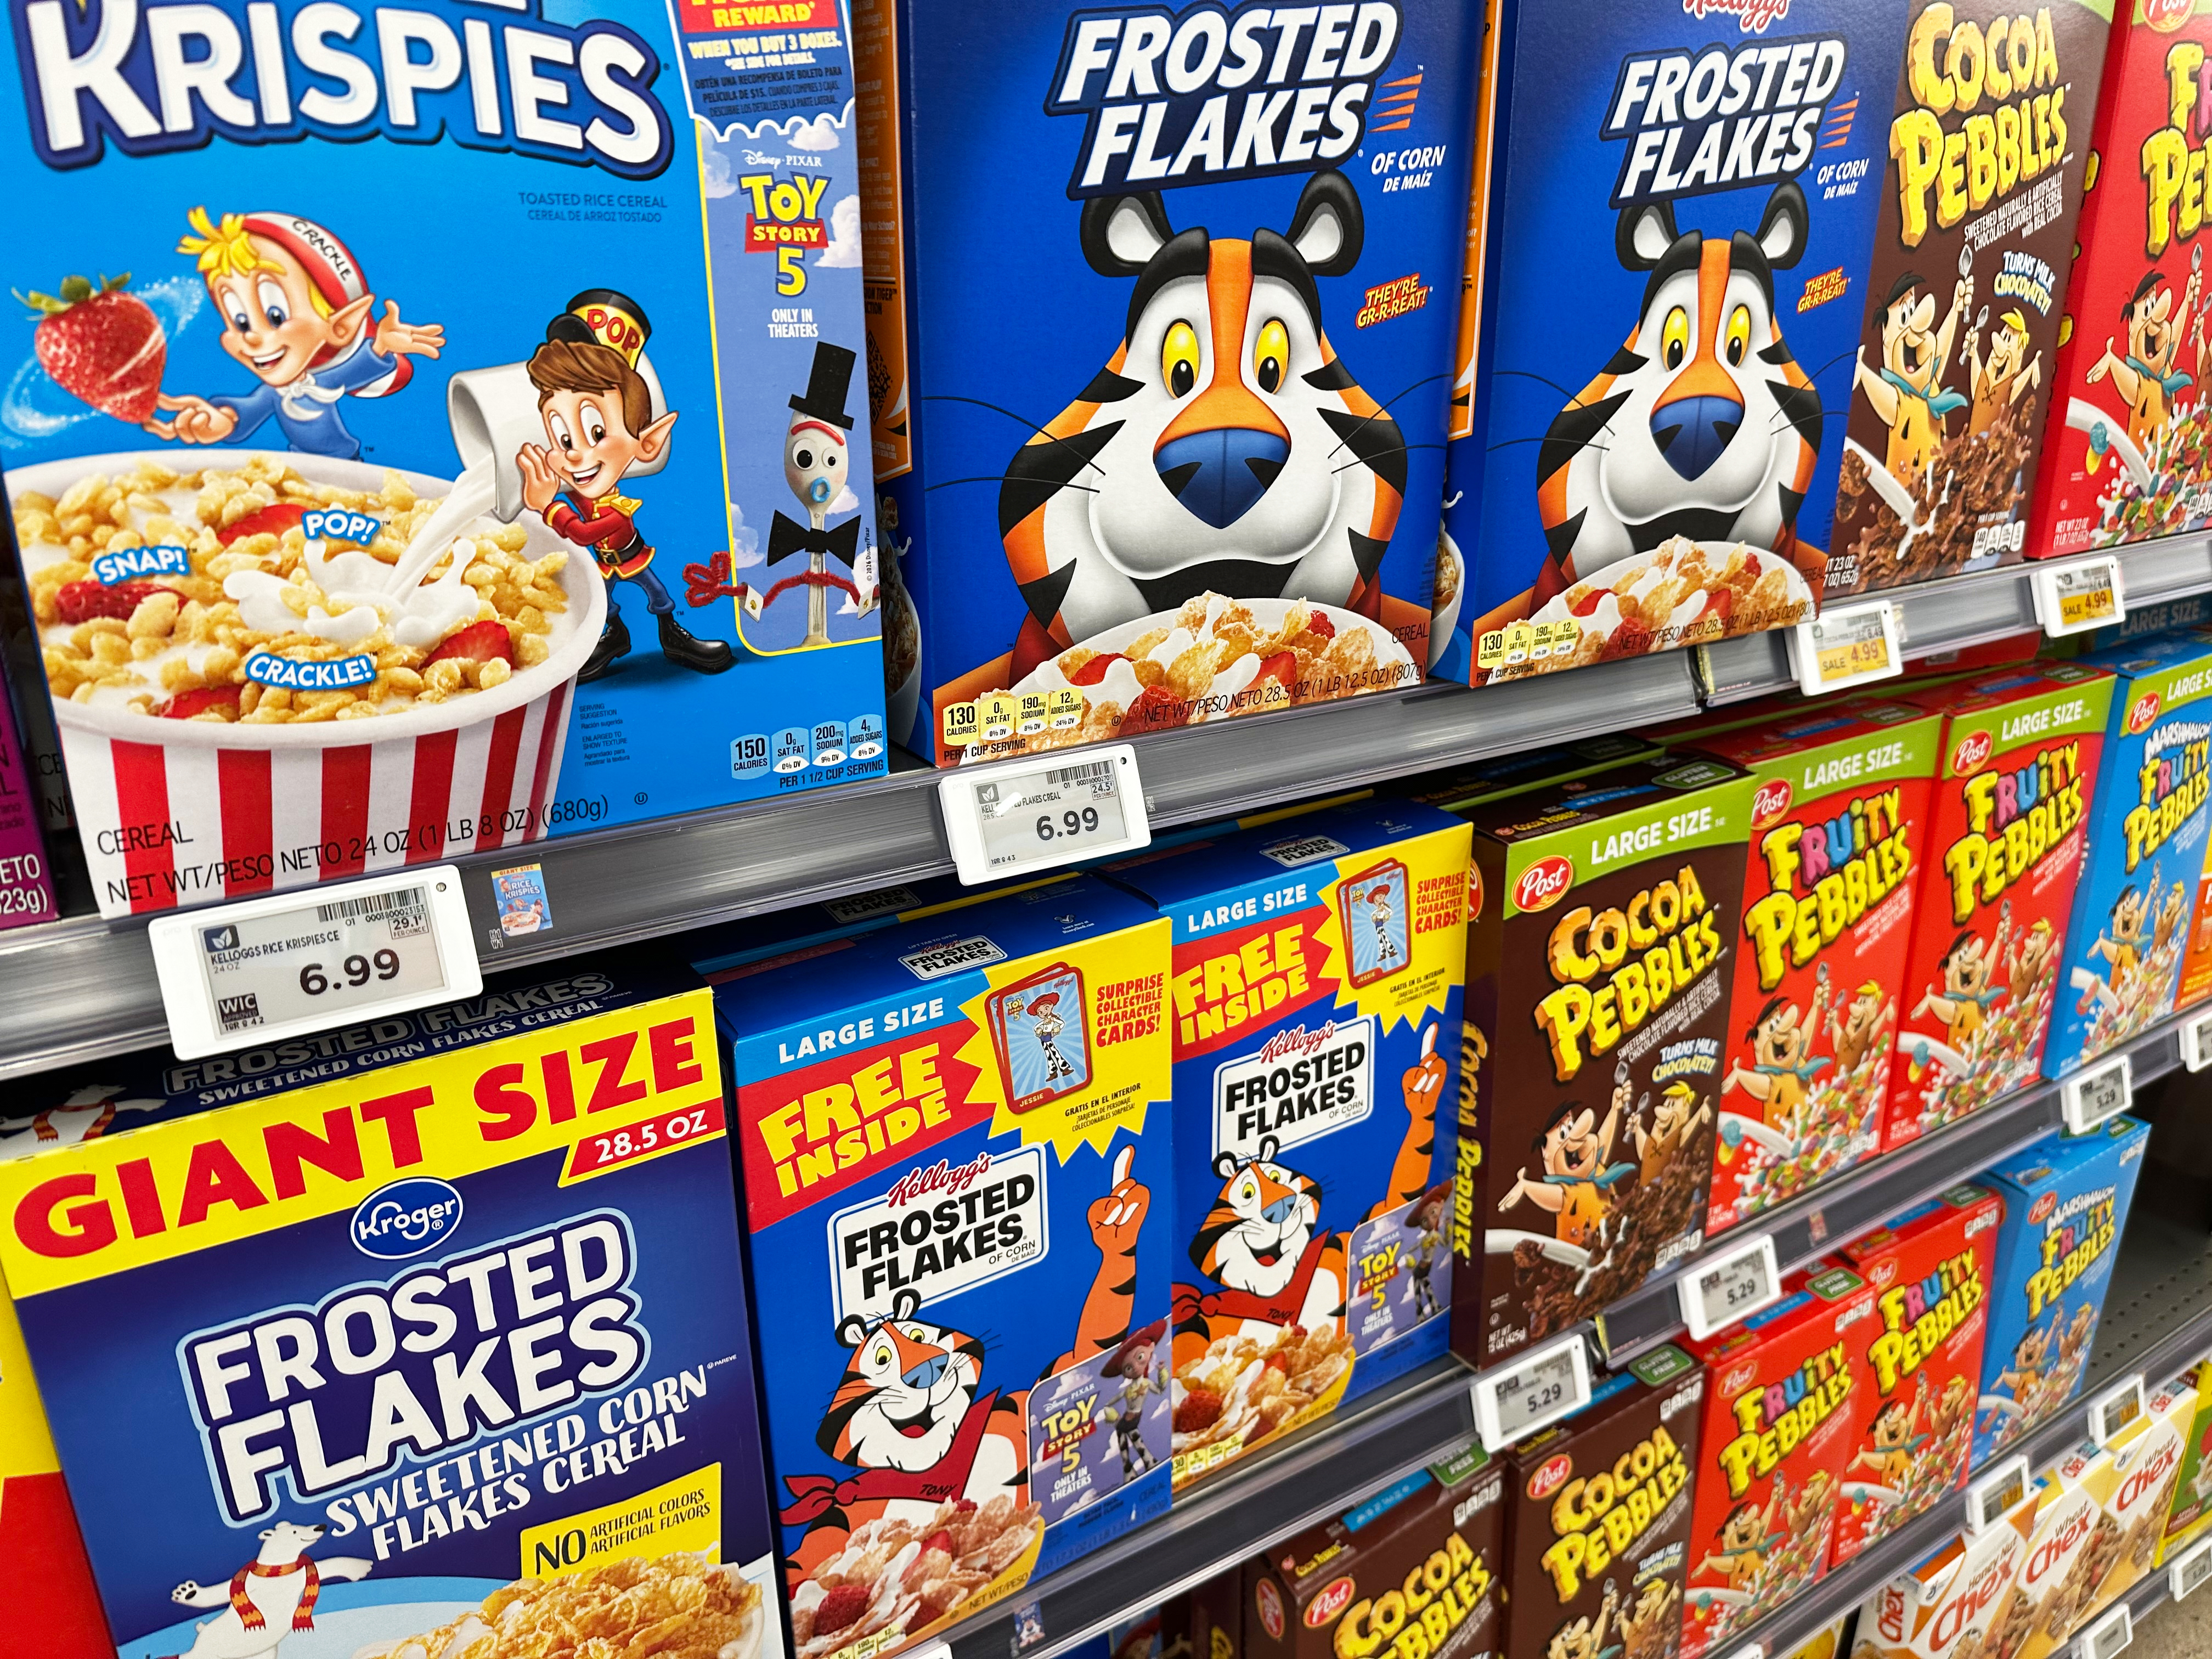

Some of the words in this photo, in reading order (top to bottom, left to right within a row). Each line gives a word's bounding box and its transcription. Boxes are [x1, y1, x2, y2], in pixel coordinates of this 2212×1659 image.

[1059, 2, 1398, 104] FROSTED
[1908, 2, 2059, 117] COCOA
[27, 1, 661, 163] KRISPIES
[1610, 38, 1847, 131] FROSTED
[1081, 83, 1368, 187] FLAKES
[1371, 151, 1396, 174] OF
[1398, 144, 1446, 171] CORN
[1619, 107, 1821, 200] FLAKES
[1889, 86, 2068, 247] PEBBLES
[518, 191, 580, 206] TOASTED
[583, 194, 616, 207] RICE
[617, 194, 668, 208] CEREAL
[738, 172, 830, 223] TOY
[1964, 210, 1997, 242] SWEETENED
[1997, 194, 2027, 218] NATURALLY
[2028, 189, 2032, 204] &
[2032, 169, 2063, 202] ARTIFICIALLY
[1974, 223, 2006, 252] CHOCOLATE
[2006, 207, 2033, 234] FLAVORED
[2033, 199, 2045, 216] RICE
[2045, 188, 2063, 210] CEREAL
[2022, 221, 2034, 239] with
[2034, 212, 2047, 232] REAL
[2046, 200, 2063, 223] COCOA
[291, 219, 352, 282] CRACKLE
[753, 225, 821, 242] STORY
[777, 246, 806, 296] 5
[1365, 274, 1419, 306] THEY'RE
[1994, 271, 2053, 318] CHOCOLATEY!
[2003, 250, 2036, 275] TURNS
[2035, 258, 2056, 294] MILK
[587, 308, 640, 353] POP
[768, 324, 819, 338] THEATERS
[771, 308, 798, 323] ONLY
[801, 308, 813, 323] IN
[1356, 289, 1428, 329] GR-R-REAT!
[304, 511, 377, 543] POP!
[97, 548, 186, 583] SNAP!
[2063, 604, 2082, 617] SALE
[2085, 591, 2107, 610] 4.99
[1482, 633, 1503, 651] 130
[1822, 657, 1846, 672] SALE
[1851, 641, 1879, 663] 4.99
[249, 658, 374, 687] CRACKLE!
[946, 725, 977, 737] CALORIES
[947, 705, 975, 727] 130
[2002, 709, 2052, 742] LARGE
[2053, 699, 2084, 728] SIZE
[2133, 697, 2158, 725] Post
[733, 758, 768, 771] CALORIES
[735, 738, 765, 760] 150
[816, 738, 843, 751] SODIUM
[1955, 736, 1989, 766] Post
[779, 774, 799, 789] PER
[800, 774, 806, 786] 1
[809, 771, 823, 785] 1/2
[826, 767, 844, 782] CUP
[847, 759, 884, 778] SERVING
[1964, 740, 2079, 835] FRUITY
[2140, 736, 2210, 805] FRUITY
[97, 820, 194, 856] CEREAL
[1036, 806, 1099, 841] 6.99
[1590, 818, 1663, 866] LARGE
[1667, 806, 1713, 842] SIZE
[1761, 786, 1900, 893] FRUITY
[2124, 763, 2210, 875] PEBBLES
[107, 873, 156, 904] NET
[165, 853, 274, 894] WT/PESO
[280, 843, 343, 873] NETO
[349, 835, 378, 859] 24
[383, 830, 412, 853] OZ
[419, 823, 437, 852] (1
[447, 818, 473, 843] LB
[480, 815, 493, 837] 8
[499, 806, 535, 834] OZ)
[541, 794, 608, 825] (680g)
[1945, 775, 2083, 926] PEBBLES
[504, 886, 540, 900] KRISPIES
[510, 881, 532, 890] RICE
[1188, 897, 1257, 933] LARGE
[1263, 884, 1307, 912] SIZE
[1522, 864, 1566, 905] Post
[1744, 823, 1911, 990] PEBBLES
[211, 942, 261, 966] KELLOGGS
[263, 942, 284, 956] RICE
[286, 933, 326, 952] KRISPIES
[328, 930, 340, 943] CE
[1547, 863, 1706, 985] COCOA
[300, 948, 400, 996] 6.99
[1096, 972, 1164, 1002] SURPRISE
[1172, 923, 1305, 1016] FREE
[220, 995, 256, 1014] WIC
[1096, 988, 1163, 1015] COLLECTIBLE
[1096, 1001, 1161, 1028] CHARACTER
[1180, 963, 1310, 1046] INSIDE
[1534, 909, 1720, 1082] PEBBLES
[778, 1018, 874, 1064] LARGE
[884, 997, 944, 1032] SIZE
[1096, 1013, 1161, 1048] CARDS!
[1065, 1102, 1089, 1117] GRATIS
[1091, 1099, 1099, 1108] EN
[1102, 1096, 1109, 1105] EL
[1111, 1082, 1141, 1101] INTERIOR
[1225, 1041, 1367, 1113] FROSTED
[2097, 1088, 2116, 1110] 5.29
[758, 1042, 941, 1165] FREE
[1237, 1076, 1356, 1141] FLAKES
[13, 1084, 436, 1259] GIANT
[473, 1015, 703, 1143] SIZE
[594, 1122, 658, 1164] 28.5
[665, 1109, 708, 1139] OZ
[775, 1087, 952, 1199] INSIDE
[888, 1153, 992, 1208] Kellogg's
[358, 1195, 457, 1241] Kroger
[843, 1173, 1036, 1271] FROSTED
[2041, 1198, 2115, 1268] FRUITY
[862, 1212, 1024, 1301] FLAKES
[2027, 1217, 2116, 1324] PEBBLES
[1726, 1278, 1757, 1306] 5.29
[1877, 1247, 1974, 1333] FRUITY
[193, 1219, 624, 1421] FROSTED
[1869, 1265, 1984, 1398] PEBBLES
[218, 1304, 637, 1516] FLAKES
[1527, 1382, 1561, 1413] 5.29
[1733, 1340, 1844, 1435] FRUITY
[1041, 1393, 1098, 1440] TOY
[1047, 1422, 1092, 1454] STORY
[1720, 1362, 1853, 1500] PEBBLES
[330, 1420, 587, 1538] SWEETENED
[596, 1364, 708, 1435] CORN
[1062, 1440, 1081, 1474] 5
[2144, 1434, 2175, 1468] Wheat
[373, 1472, 533, 1562] FLAKES
[542, 1414, 686, 1493] CEREAL
[920, 1483, 956, 1496] TONY
[1534, 1462, 1567, 1496] Post
[1549, 1426, 1679, 1537] COCOA
[2116, 1444, 2177, 1512] Chex
[534, 1527, 586, 1576] NO
[589, 1509, 655, 1540] ARTIFICIAL
[657, 1487, 705, 1517] COLORS
[589, 1523, 657, 1556] ARTIFICIAL
[659, 1501, 711, 1532] FLAVORS
[1539, 1452, 1688, 1605] PEBBLES
[2055, 1500, 2089, 1536] Wheat
[1968, 1562, 1999, 1594] Honey
[1999, 1534, 2018, 1561] Nut
[2025, 1508, 2091, 1584] Chex
[1928, 1544, 2016, 1652] Chex
